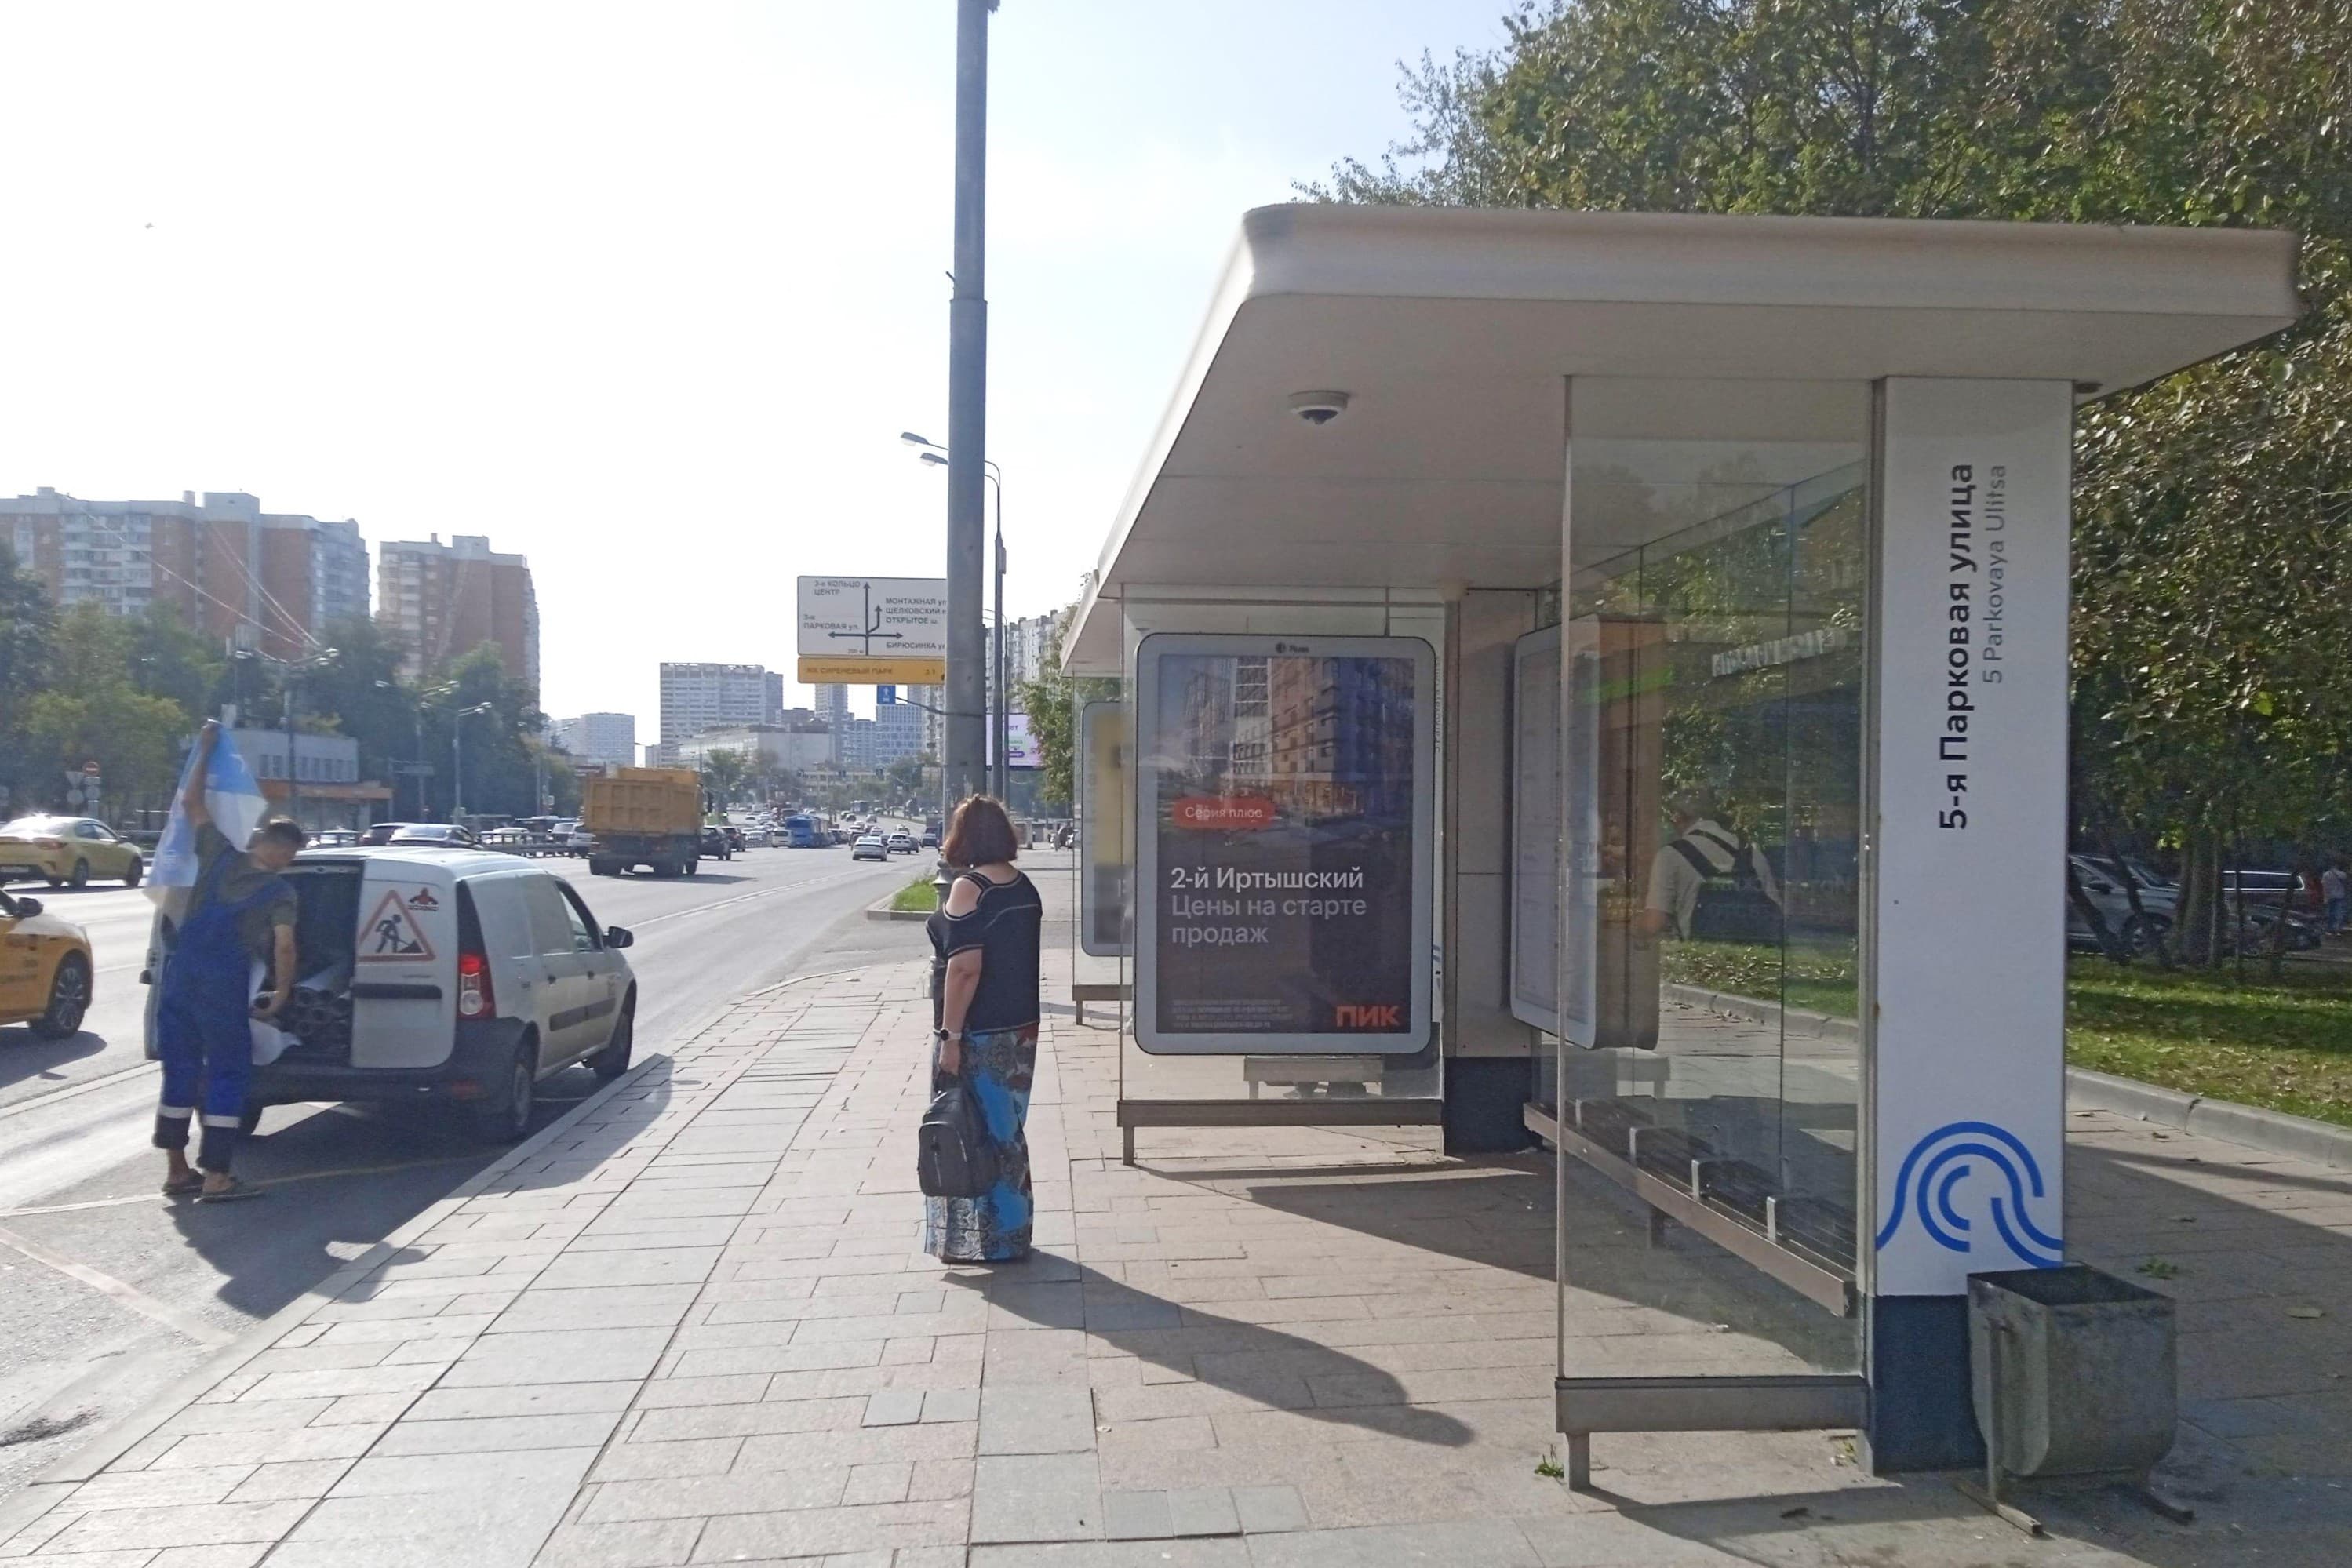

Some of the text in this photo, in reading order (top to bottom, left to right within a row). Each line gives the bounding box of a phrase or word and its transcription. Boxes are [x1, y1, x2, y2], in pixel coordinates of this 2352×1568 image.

[827, 580, 861, 588] КОЛЬЦО
[1982, 465, 2008, 683] 5 Parkovaya Ulitsa
[1939, 464, 1977, 830] 5-я Парковая улица
[1185, 806, 1263, 820] Серия плюс
[1171, 866, 1364, 893] 2-й Иртышский
[1172, 894, 1367, 919] Цены на старте
[1171, 926, 1269, 948] продаж
[1336, 1006, 1400, 1028] ПИК
